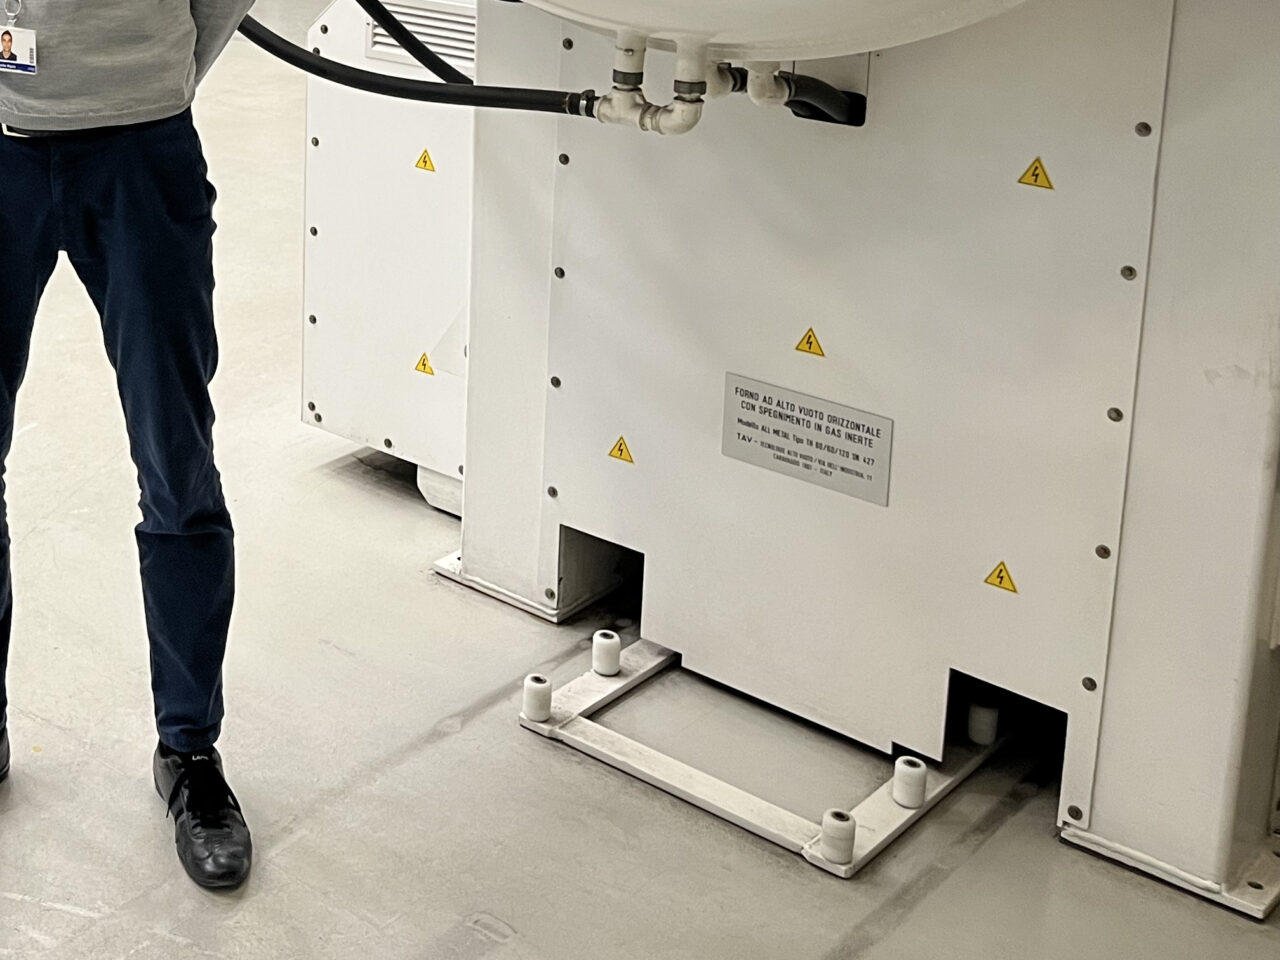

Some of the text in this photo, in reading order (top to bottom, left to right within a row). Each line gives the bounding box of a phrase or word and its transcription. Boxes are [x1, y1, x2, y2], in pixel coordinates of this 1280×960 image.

[735, 386, 881, 439] FORNO AD ALTO VUOTO ORIZZONTALE
[741, 400, 874, 448] CON SPEGNIMENTO IN GAS INERTE
[737, 432, 753, 443] TAV
